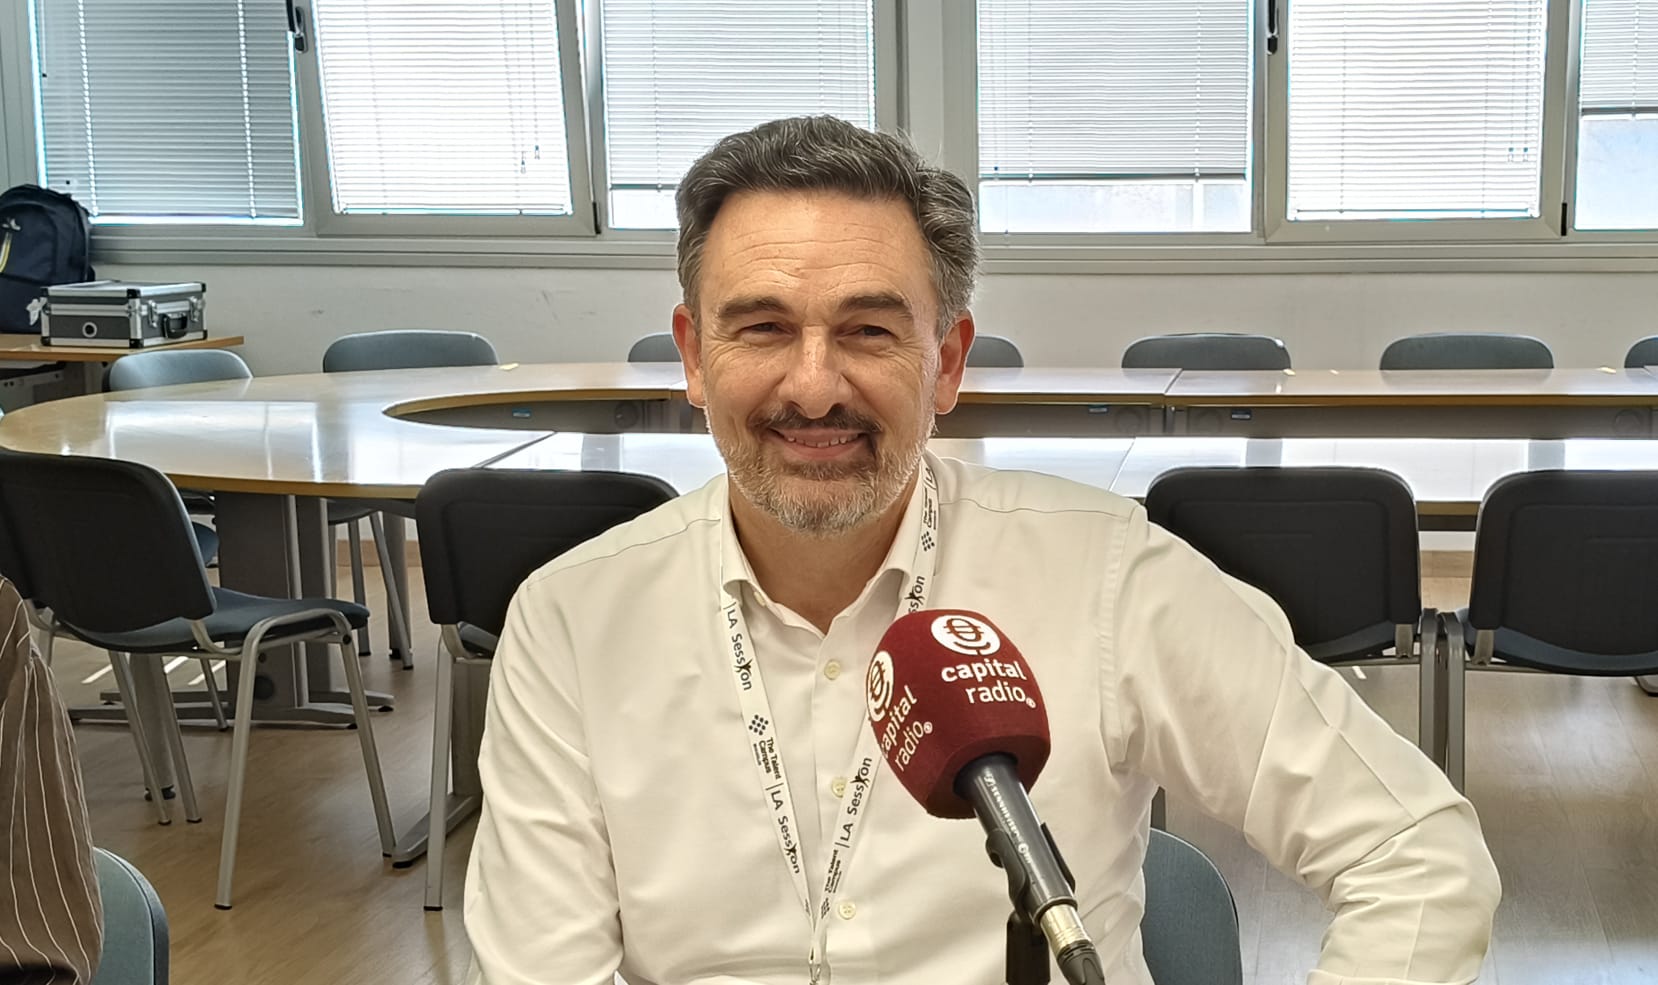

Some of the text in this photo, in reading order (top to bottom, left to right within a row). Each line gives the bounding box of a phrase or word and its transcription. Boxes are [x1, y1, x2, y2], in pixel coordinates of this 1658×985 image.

[727, 609, 738, 629] LA
[941, 658, 1027, 682] capital
[758, 740, 772, 774] Campus
[770, 790, 784, 810] LA
[840, 823, 853, 842] LA
